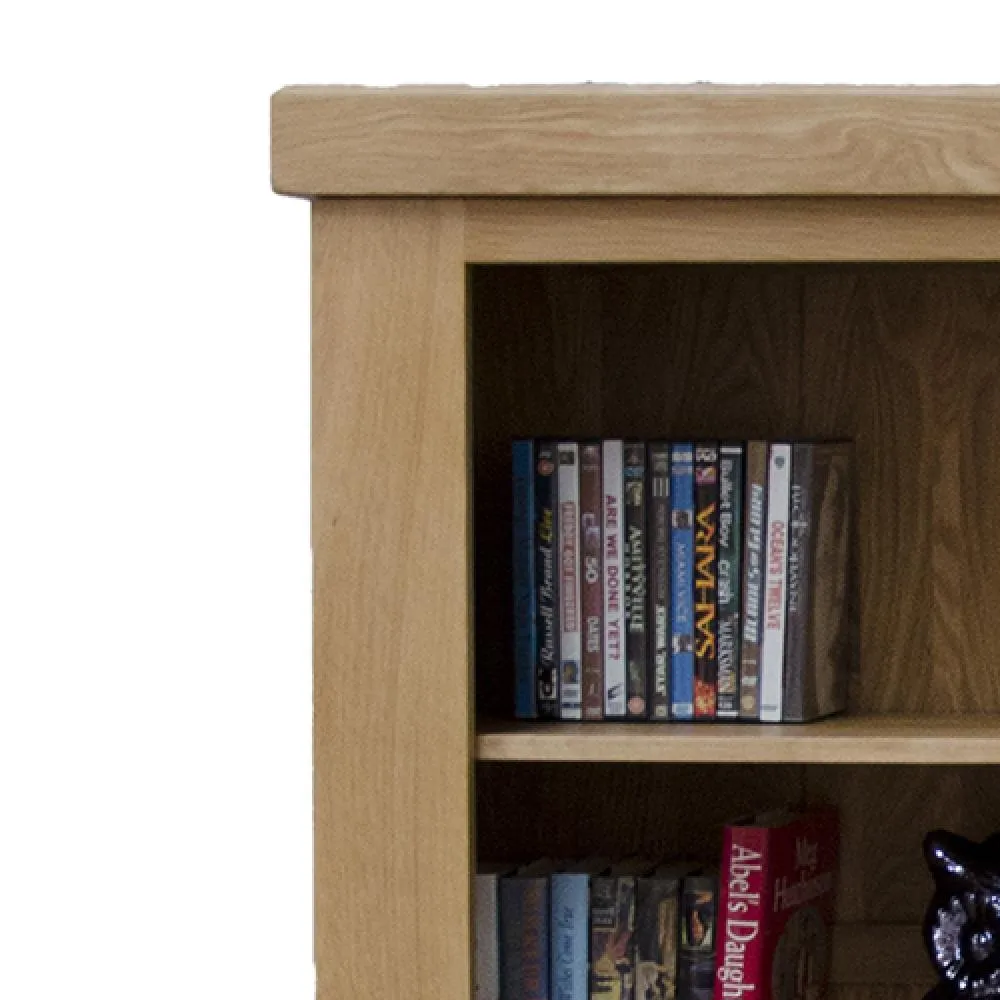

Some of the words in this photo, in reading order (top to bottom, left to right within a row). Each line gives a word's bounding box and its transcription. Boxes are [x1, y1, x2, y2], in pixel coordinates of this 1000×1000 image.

[606, 495, 617, 529] ARE
[606, 535, 618, 560] WE
[607, 565, 619, 612] DONE
[628, 525, 647, 633] AMITYVILLE
[695, 502, 717, 660] SAHARA
[608, 620, 620, 660] YET?
[728, 843, 762, 914] Abel's
